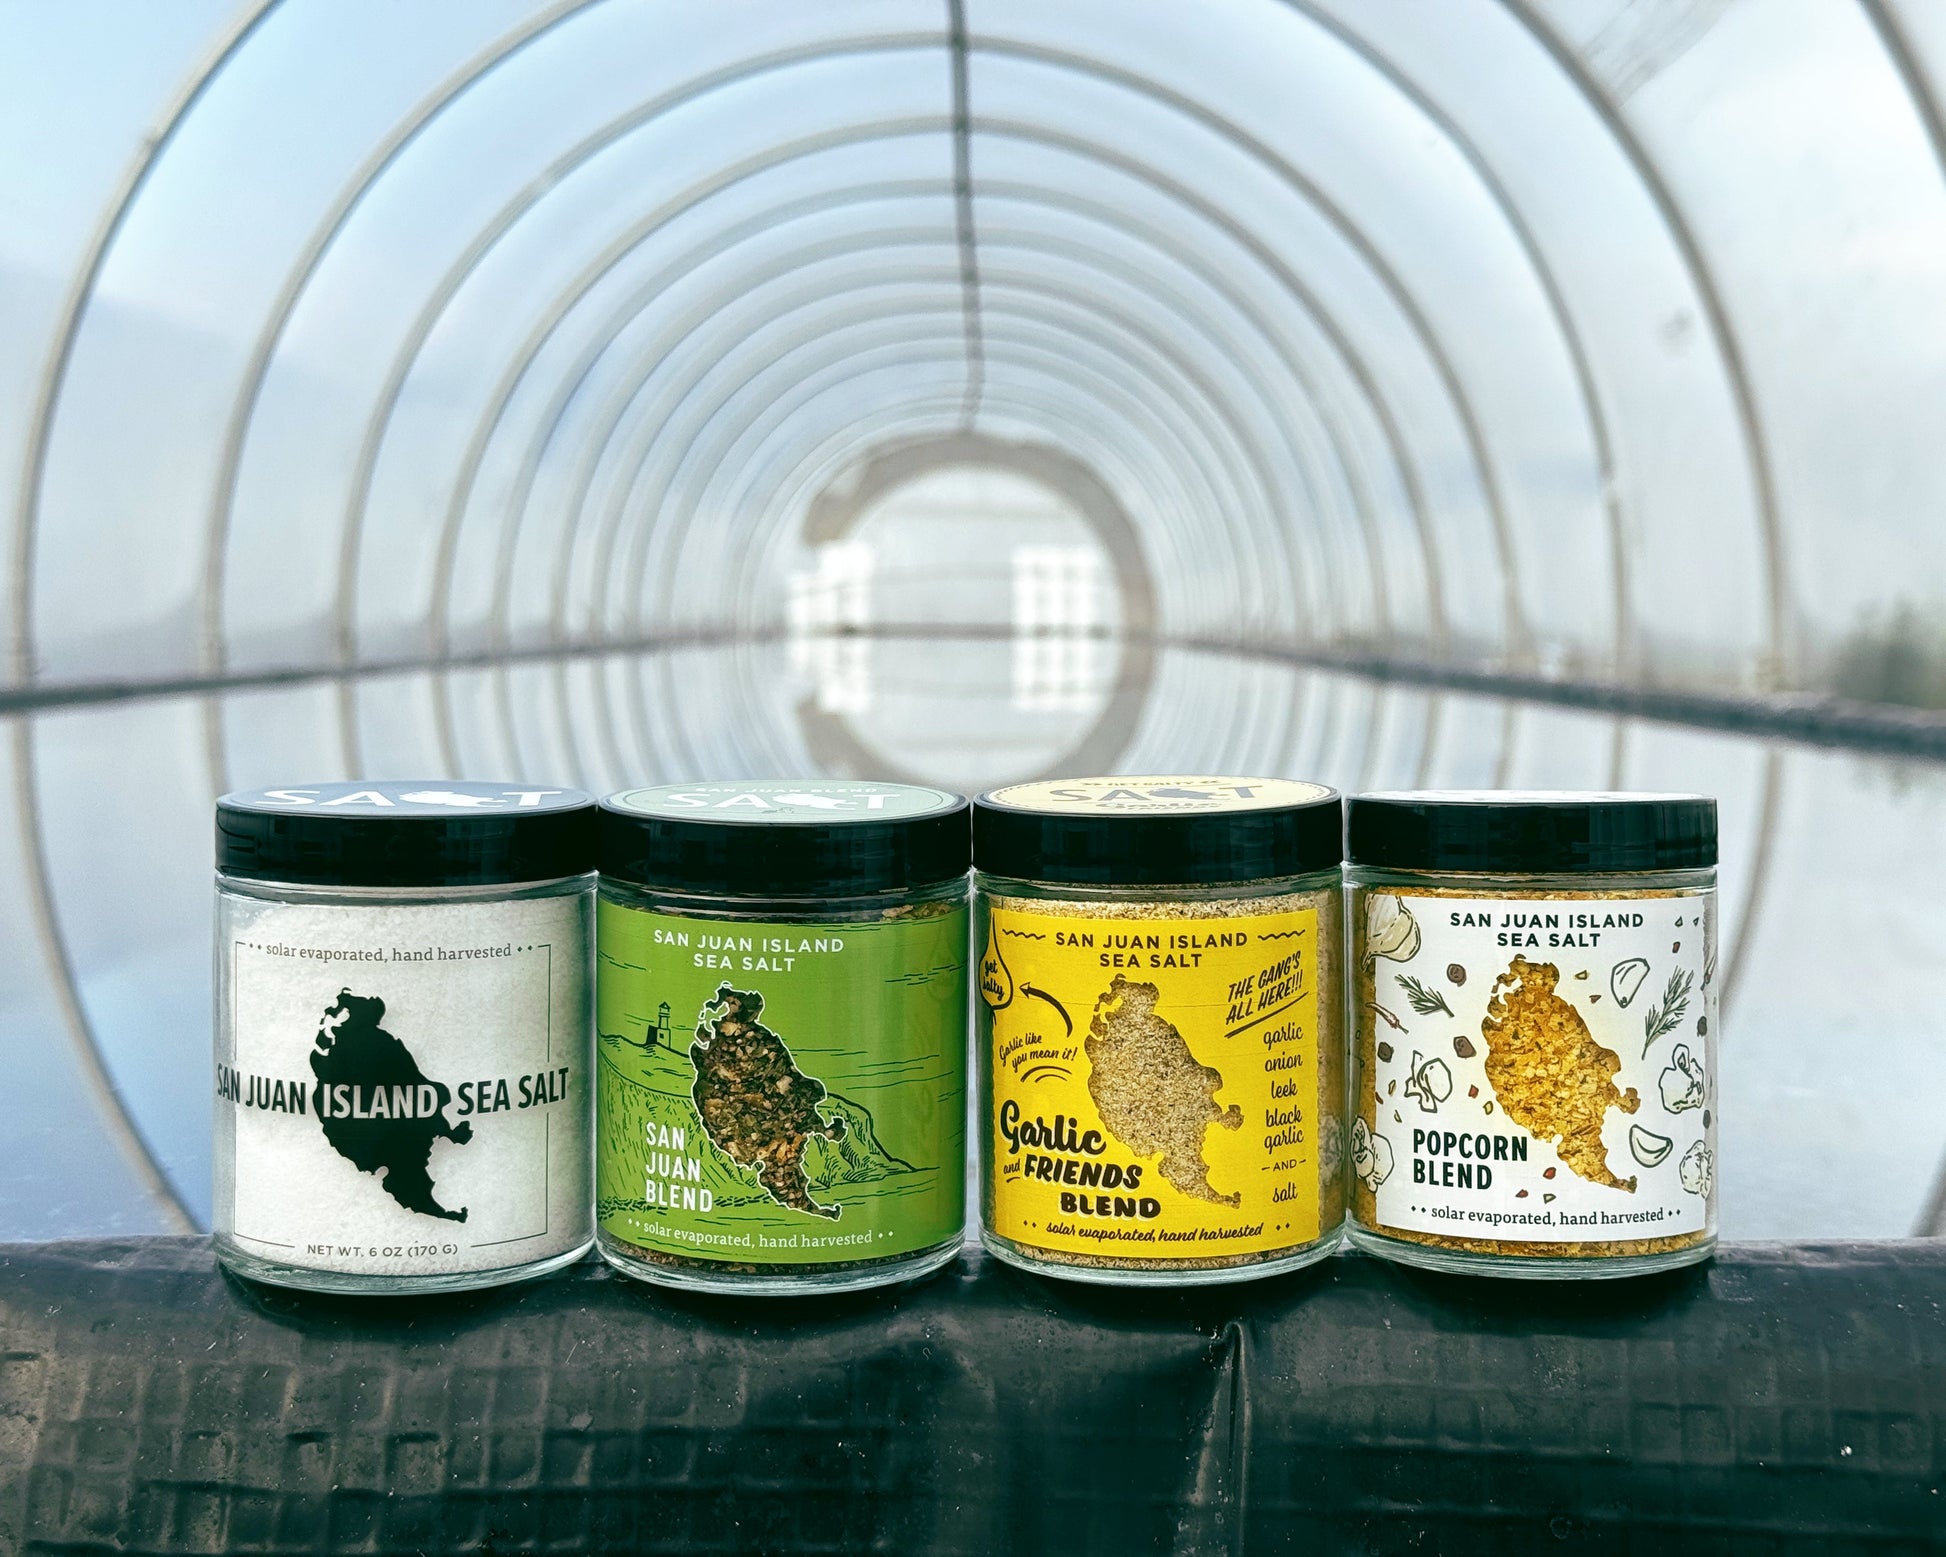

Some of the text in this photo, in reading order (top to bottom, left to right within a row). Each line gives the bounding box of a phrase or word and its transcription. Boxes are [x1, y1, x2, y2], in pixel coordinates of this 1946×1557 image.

[1450, 912, 1644, 928] SAN JUAN ISLAND
[654, 929, 844, 953] SAN JUAN ISLAND
[1056, 932, 1248, 949] SAN JUAN ISLAND
[1497, 932, 1601, 947] SEA SALT
[266, 943, 512, 964] solar evaporated, hand harvested
[693, 953, 795, 972] SEA SALT
[1100, 953, 1202, 968] SEA SALT
[984, 959, 998, 977] get
[1228, 950, 1302, 1003] THE GANG'S
[982, 976, 1005, 1001] salty
[1225, 968, 1304, 1026] ALL HERE!!!
[1263, 1022, 1304, 1051] garlic
[999, 1032, 1042, 1067] Garlic like
[1012, 1047, 1078, 1073] you mean it!
[1264, 1051, 1303, 1073] onion
[217, 1062, 569, 1119] SAN JUAN ISLAND SEA SALT
[1270, 1077, 1298, 1099] leek
[1000, 1099, 1107, 1154] Garlic
[1265, 1104, 1303, 1128] black
[645, 1121, 685, 1150] SAN
[1264, 1126, 1304, 1155] garlic
[1413, 1128, 1528, 1162] POPCORN
[645, 1152, 700, 1182] JUAN
[1003, 1154, 1143, 1190] and FRIENDS
[1272, 1158, 1298, 1172] AND
[1413, 1158, 1493, 1190] BLEND
[645, 1179, 713, 1213] BLEND
[1272, 1181, 1298, 1203] salt
[1060, 1191, 1162, 1219] BLEND
[1431, 1206, 1664, 1227] solar evaporated, hand harvested
[643, 1221, 873, 1249] solar evaporated, hand harvested
[1046, 1222, 1265, 1245] solar evaporated, hand harvested
[307, 1243, 458, 1258] NET WT. 6 OZ (170 G)
